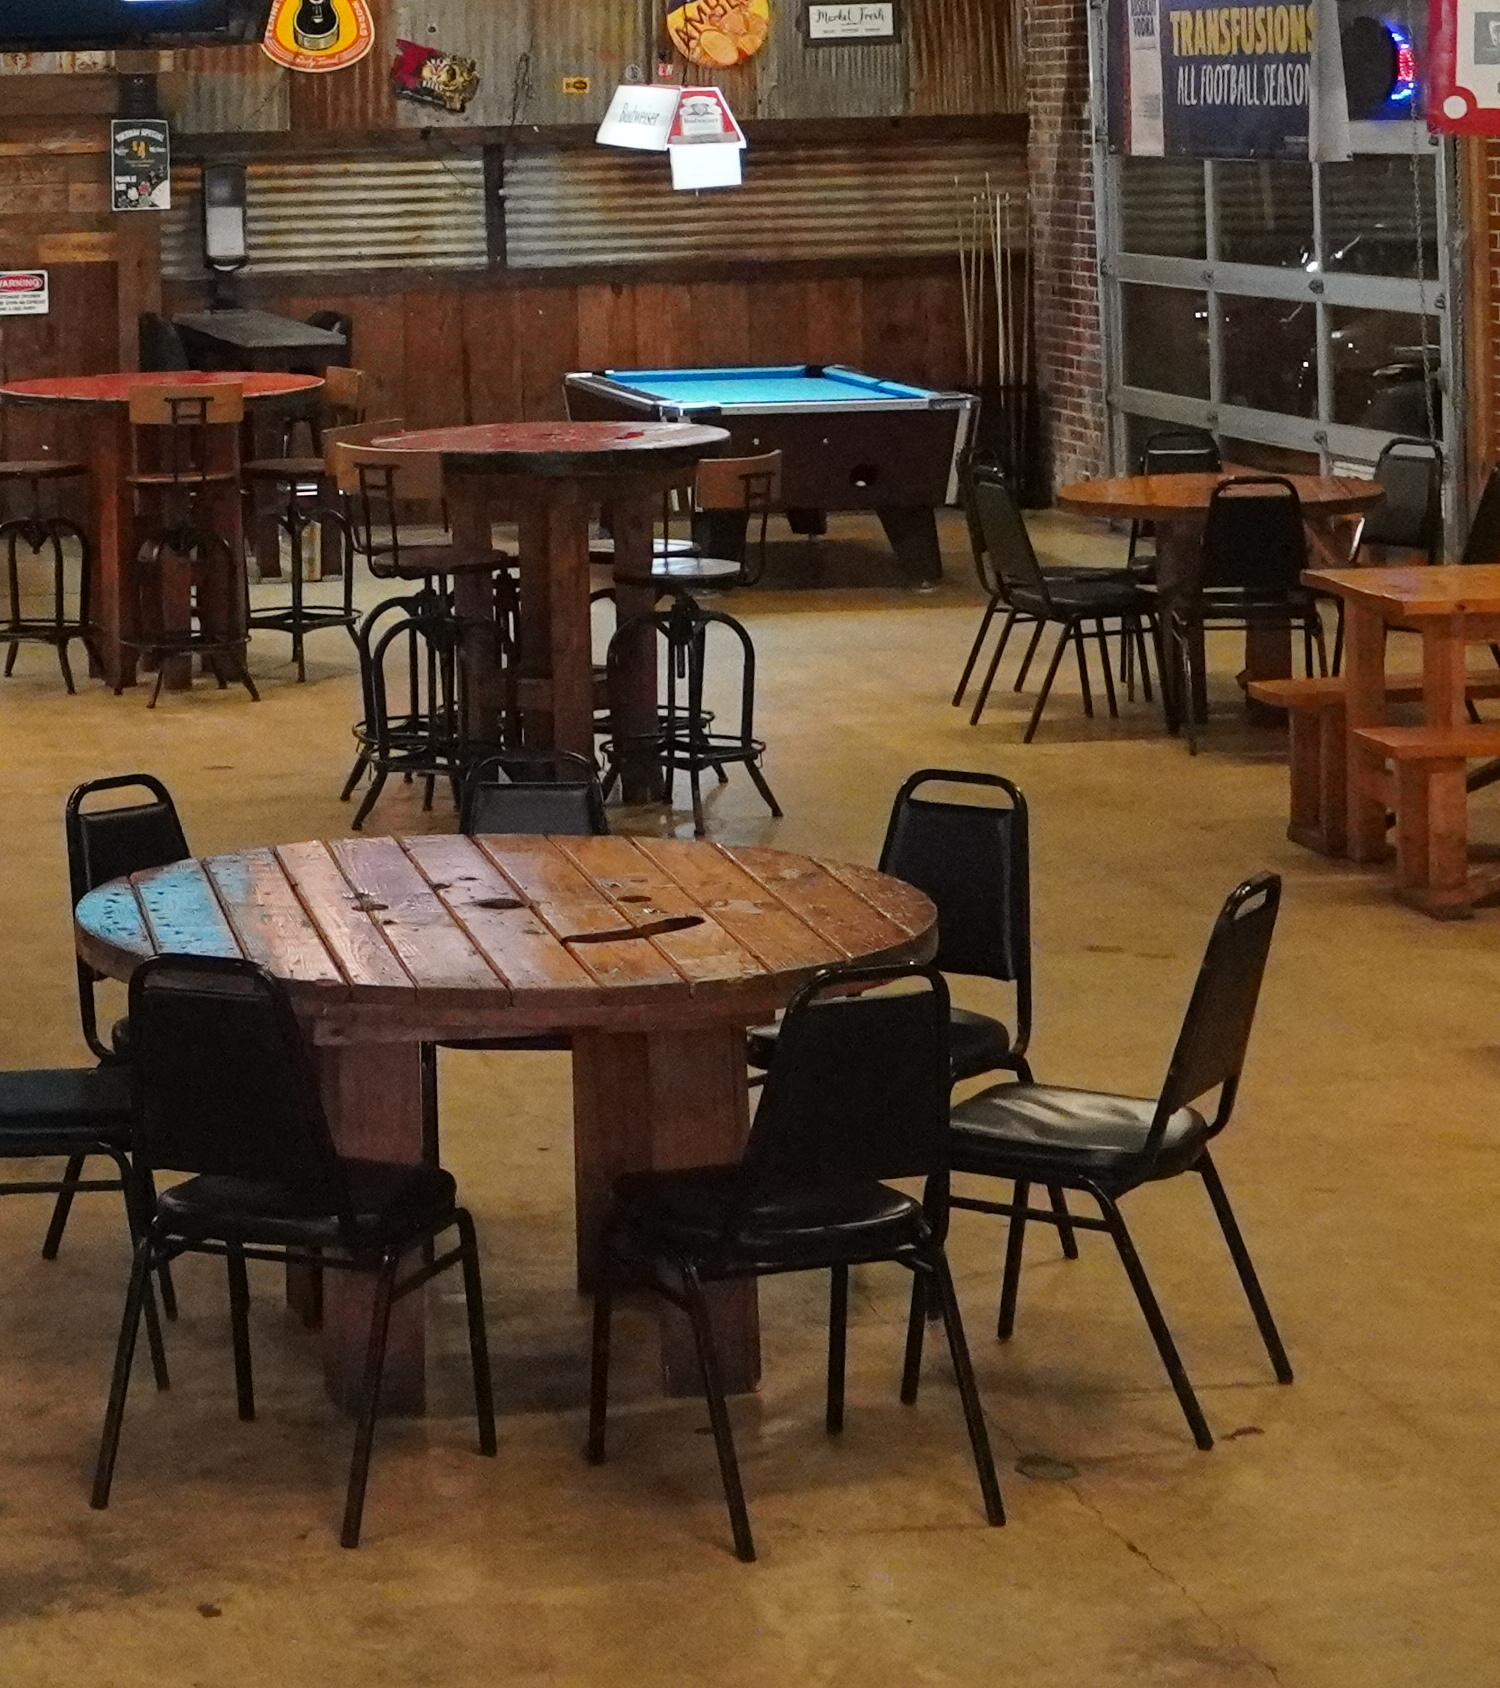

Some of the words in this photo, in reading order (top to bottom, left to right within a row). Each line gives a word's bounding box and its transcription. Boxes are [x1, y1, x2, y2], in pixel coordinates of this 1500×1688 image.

[1177, 65, 1198, 106] ALL
[1200, 63, 1261, 105] FOOTBALL
[618, 102, 660, 127] Budweiser
